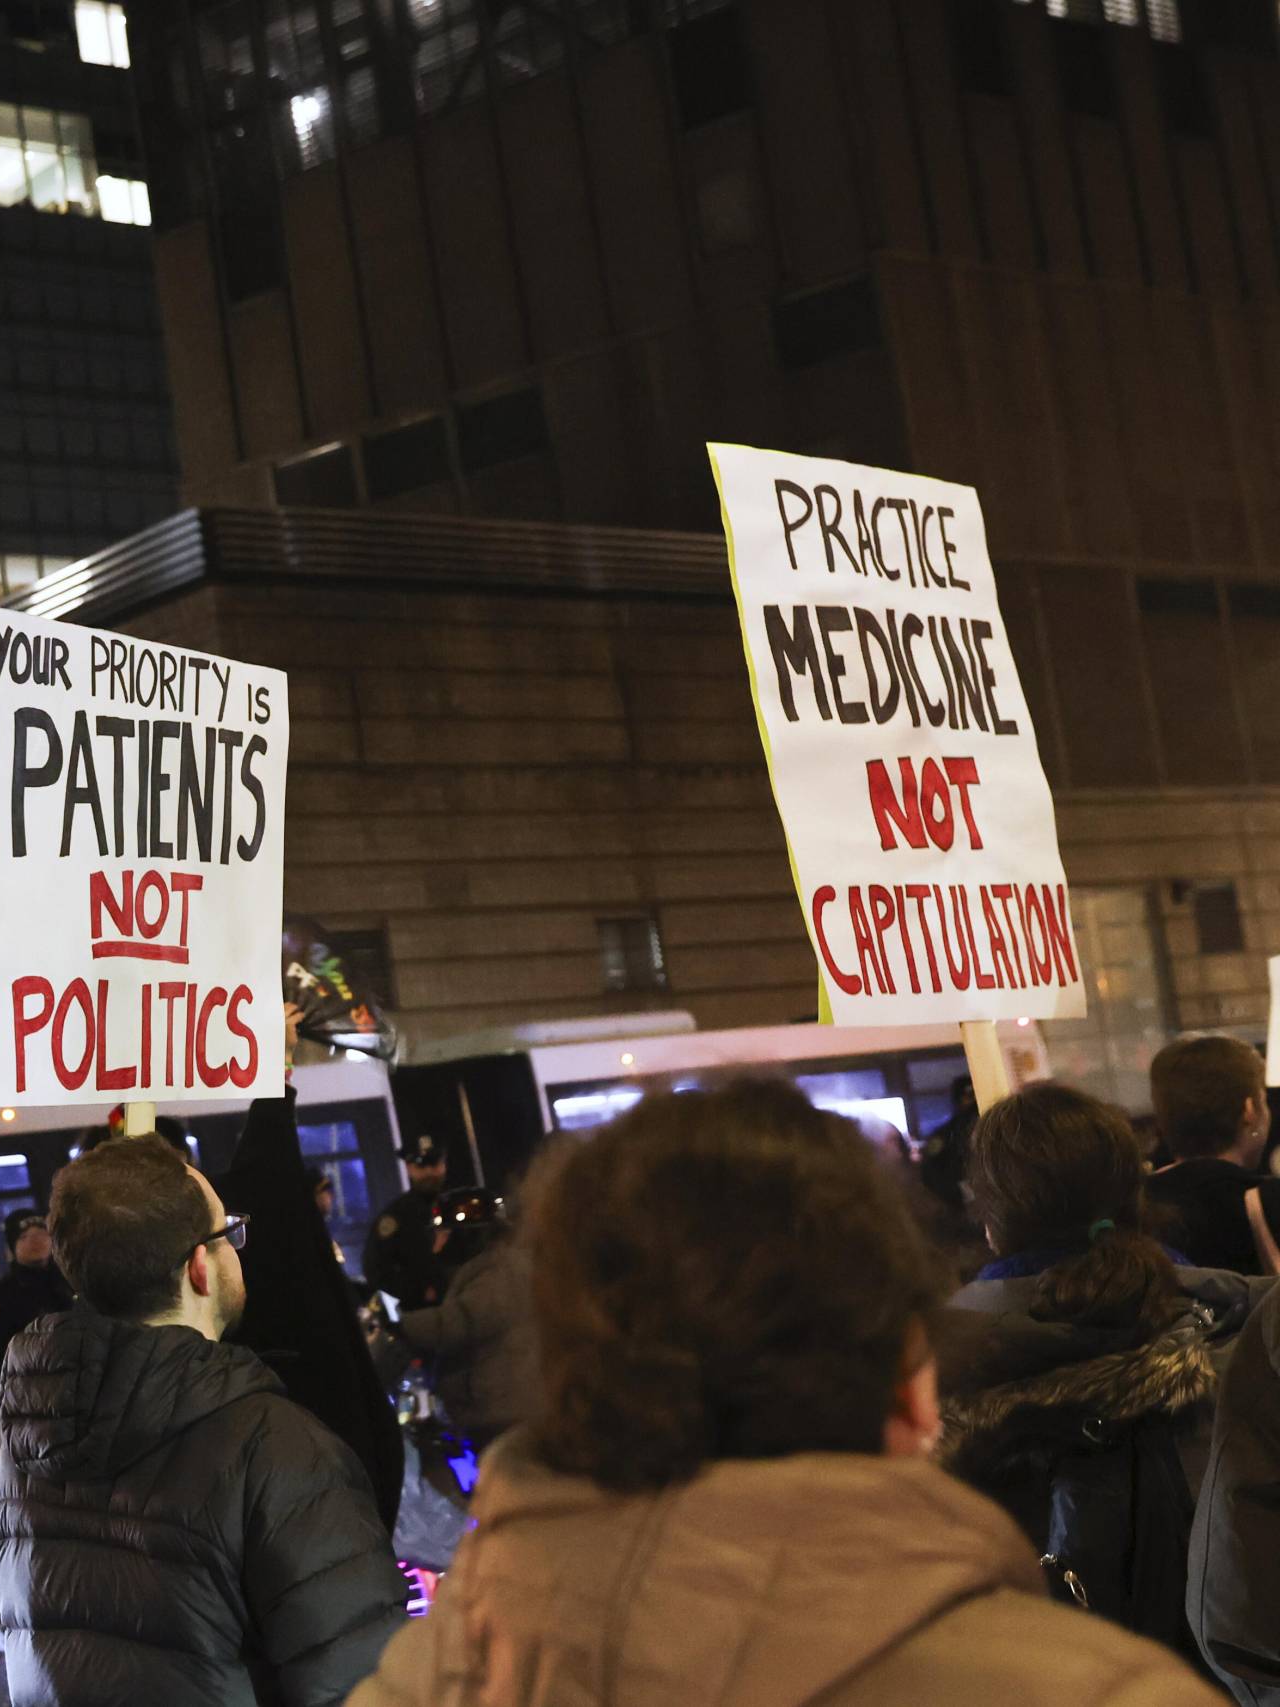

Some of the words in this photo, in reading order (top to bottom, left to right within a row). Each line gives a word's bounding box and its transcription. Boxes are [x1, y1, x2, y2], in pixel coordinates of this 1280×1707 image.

[774, 478, 971, 592] PRACTICE
[91, 635, 231, 722] PRIORITY
[247, 683, 271, 725] IS
[763, 604, 1019, 736] MEDICINE
[11, 706, 269, 865] PATIENTS
[865, 755, 984, 852] NOT
[90, 869, 204, 947] NOT
[812, 882, 1079, 997] CAPITULATION
[11, 975, 259, 1093] POLITICS
